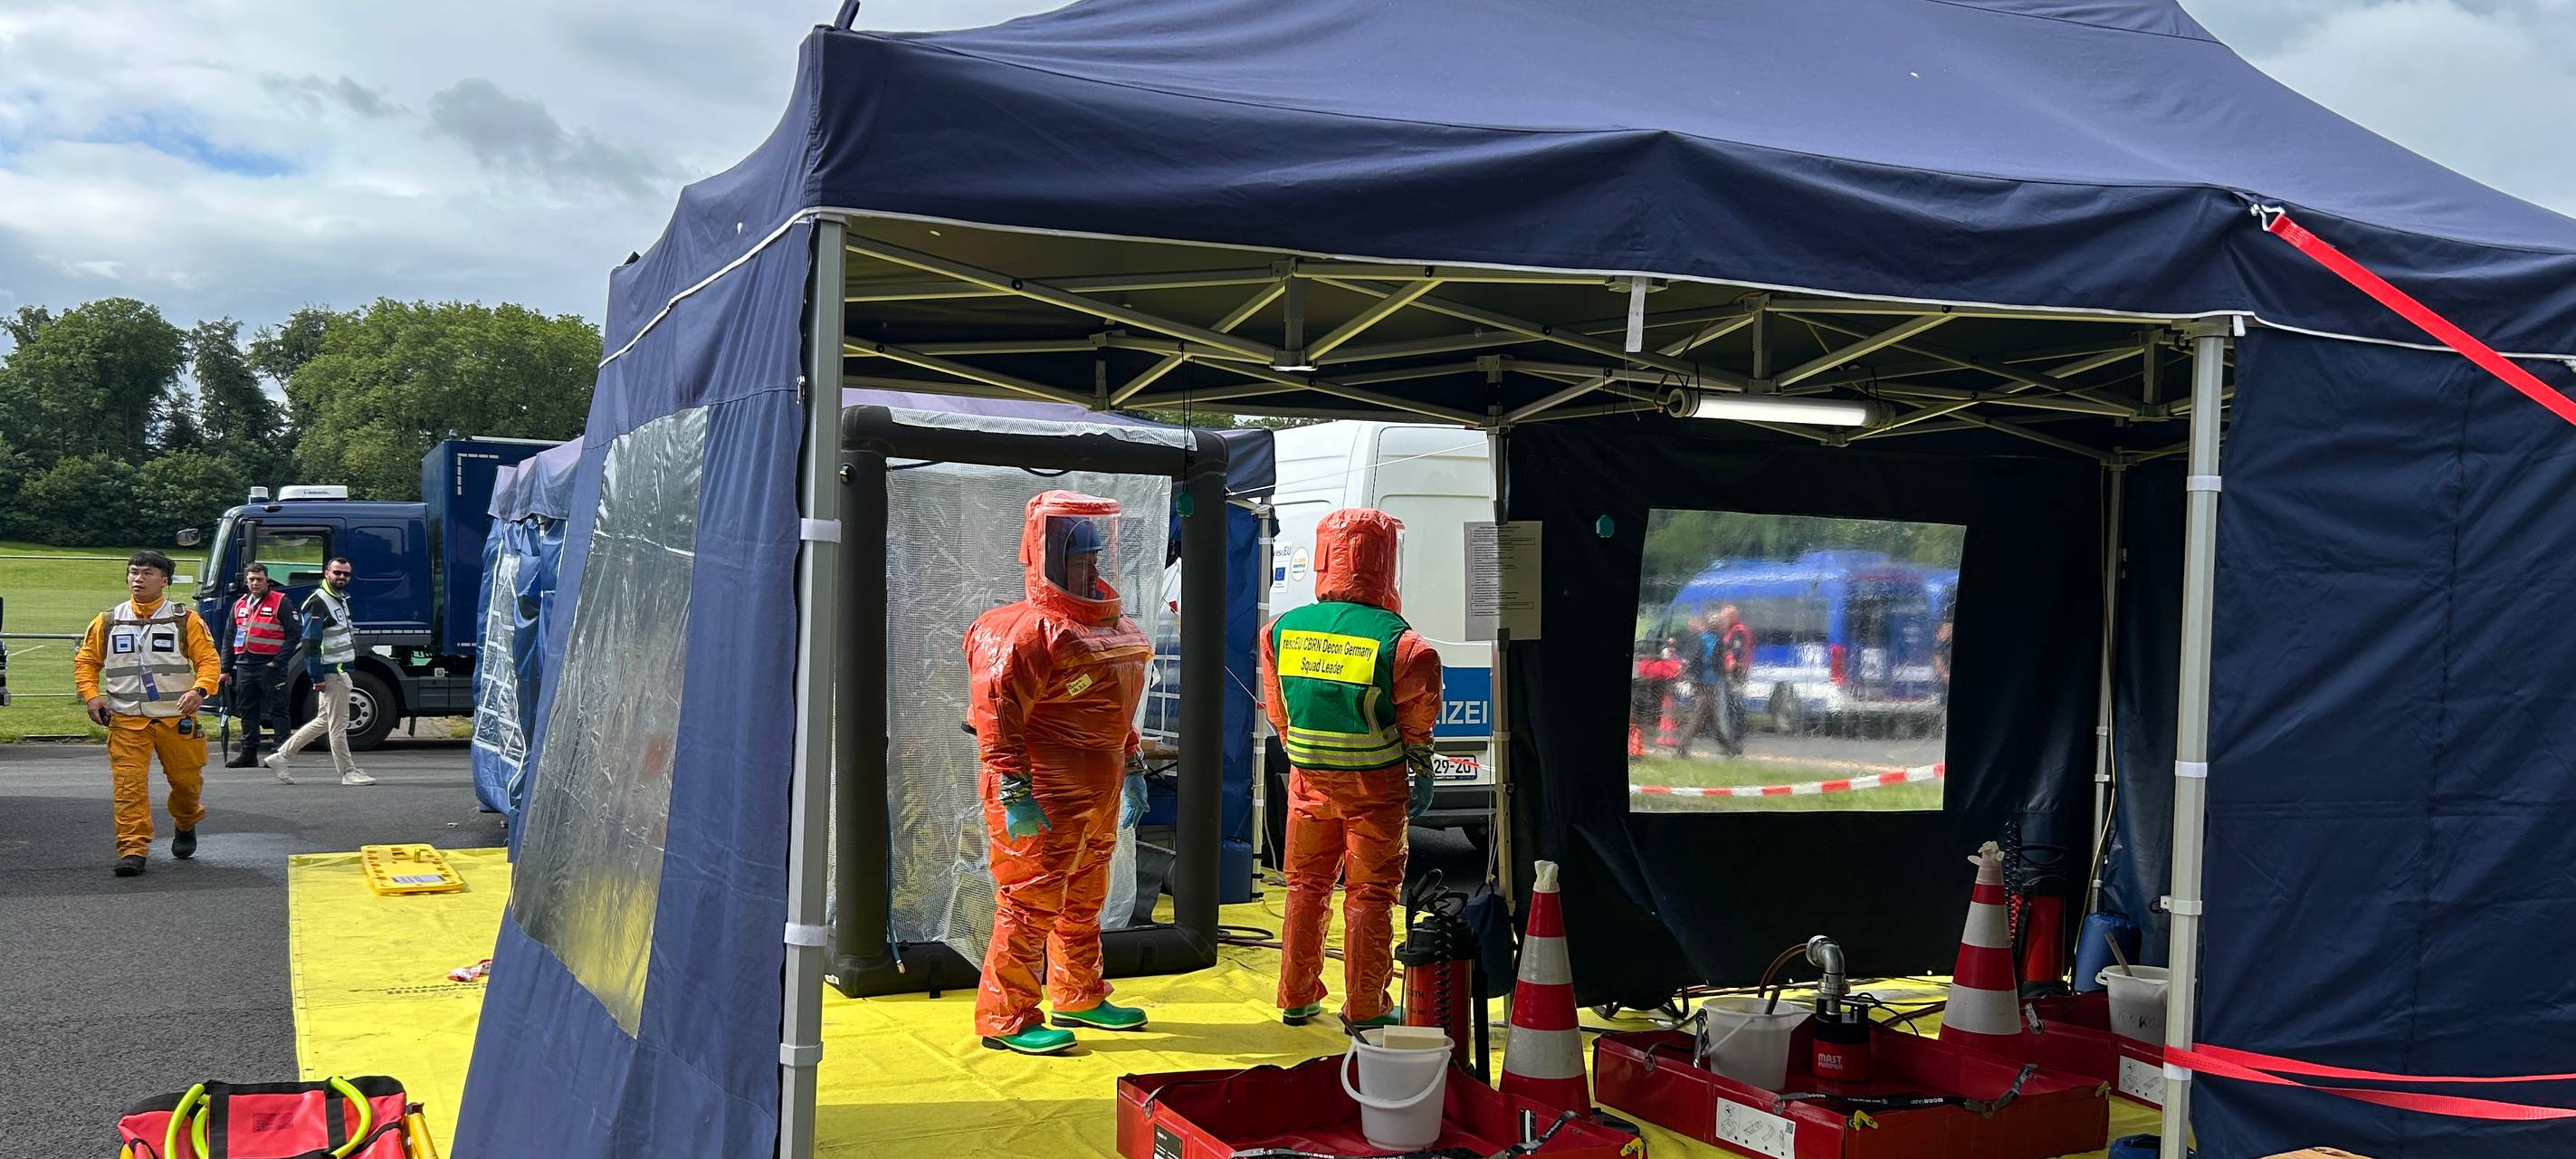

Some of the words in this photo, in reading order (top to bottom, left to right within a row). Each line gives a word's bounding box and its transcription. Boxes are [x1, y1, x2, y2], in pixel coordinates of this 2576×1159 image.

[1283, 637, 1303, 650] rescEU
[1303, 637, 1321, 652] CBRN
[1322, 639, 1343, 655] Decon
[1344, 641, 1374, 661] Germany
[1301, 657, 1321, 675] Squad
[1321, 659, 1344, 675] Leader
[1436, 701, 1488, 724] IZEI
[1818, 1053, 1843, 1064] MAST
